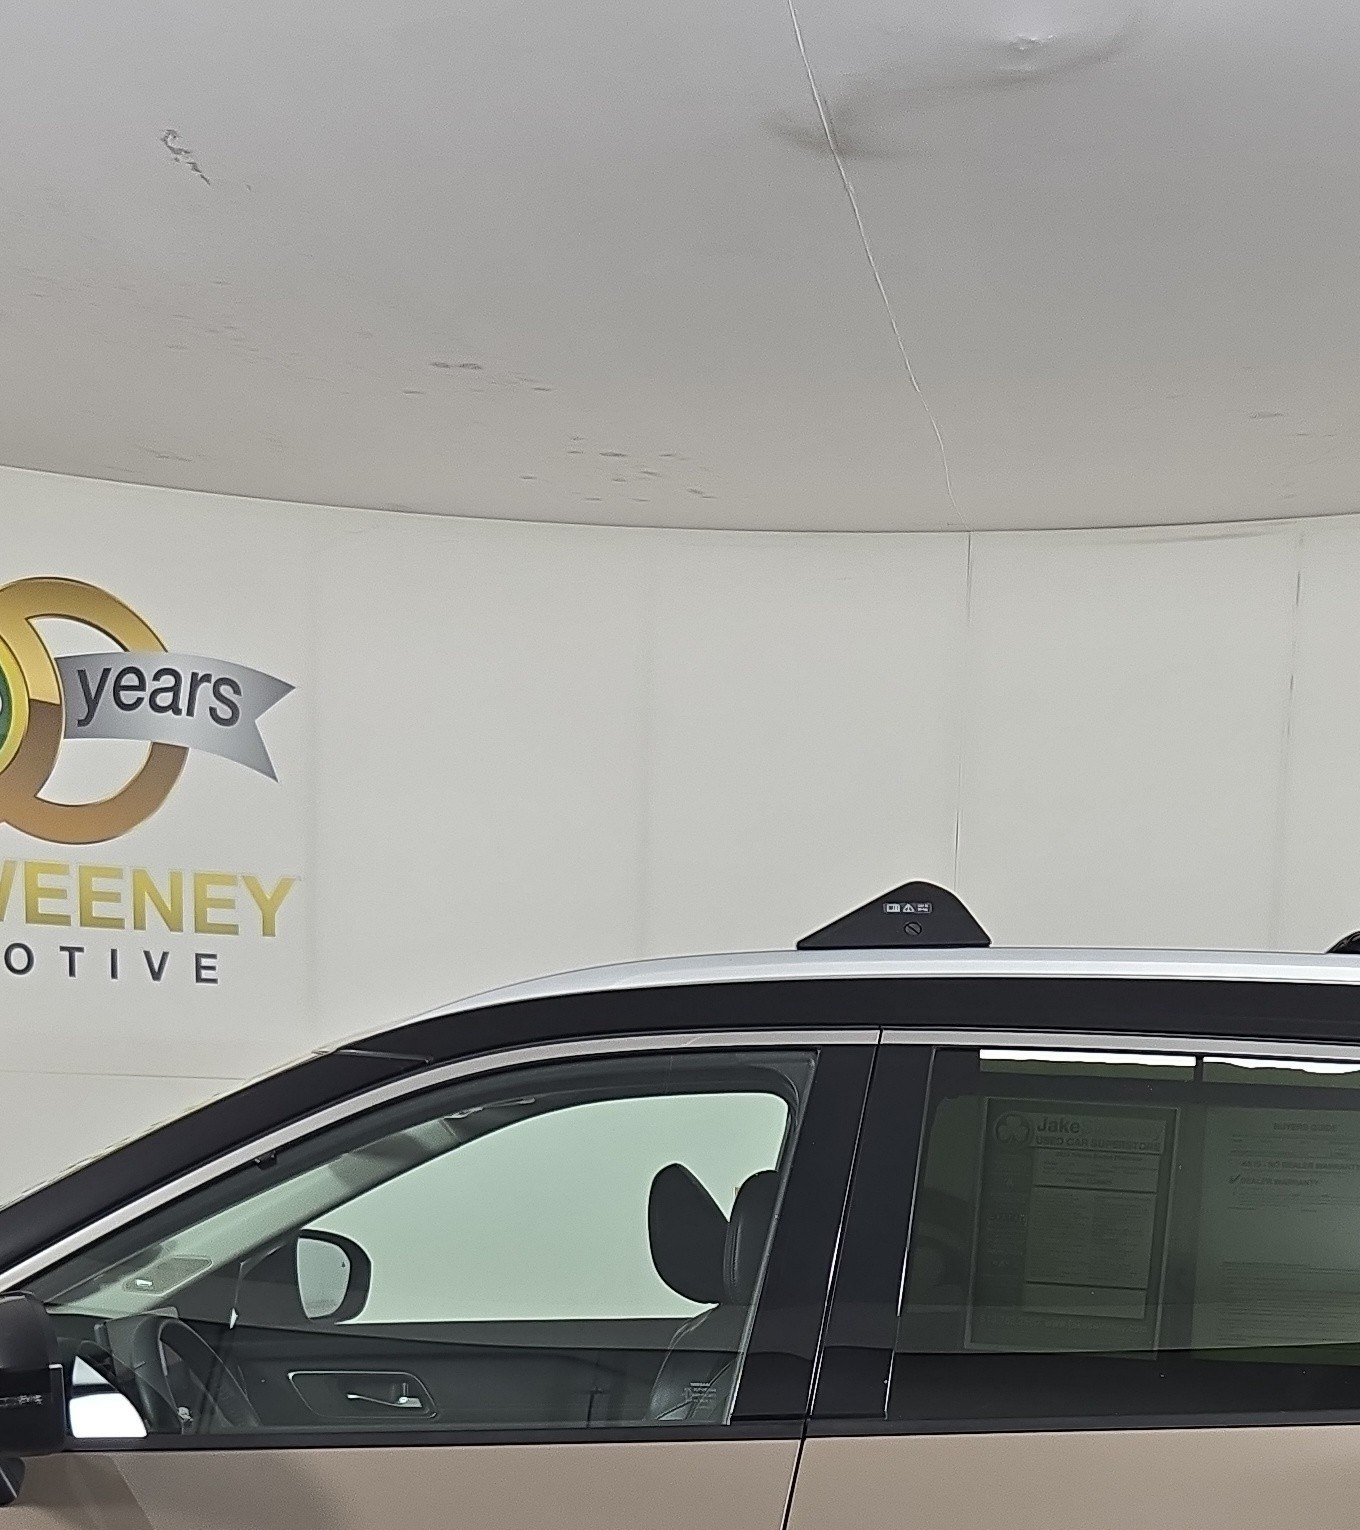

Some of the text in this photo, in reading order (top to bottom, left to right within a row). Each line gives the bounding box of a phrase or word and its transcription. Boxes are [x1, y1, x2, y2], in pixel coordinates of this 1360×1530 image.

[75, 662, 243, 729] years
[1036, 1116, 1081, 1134] Jake
[1035, 1136, 1064, 1146] USED
[1066, 1138, 1089, 1148] CAR
